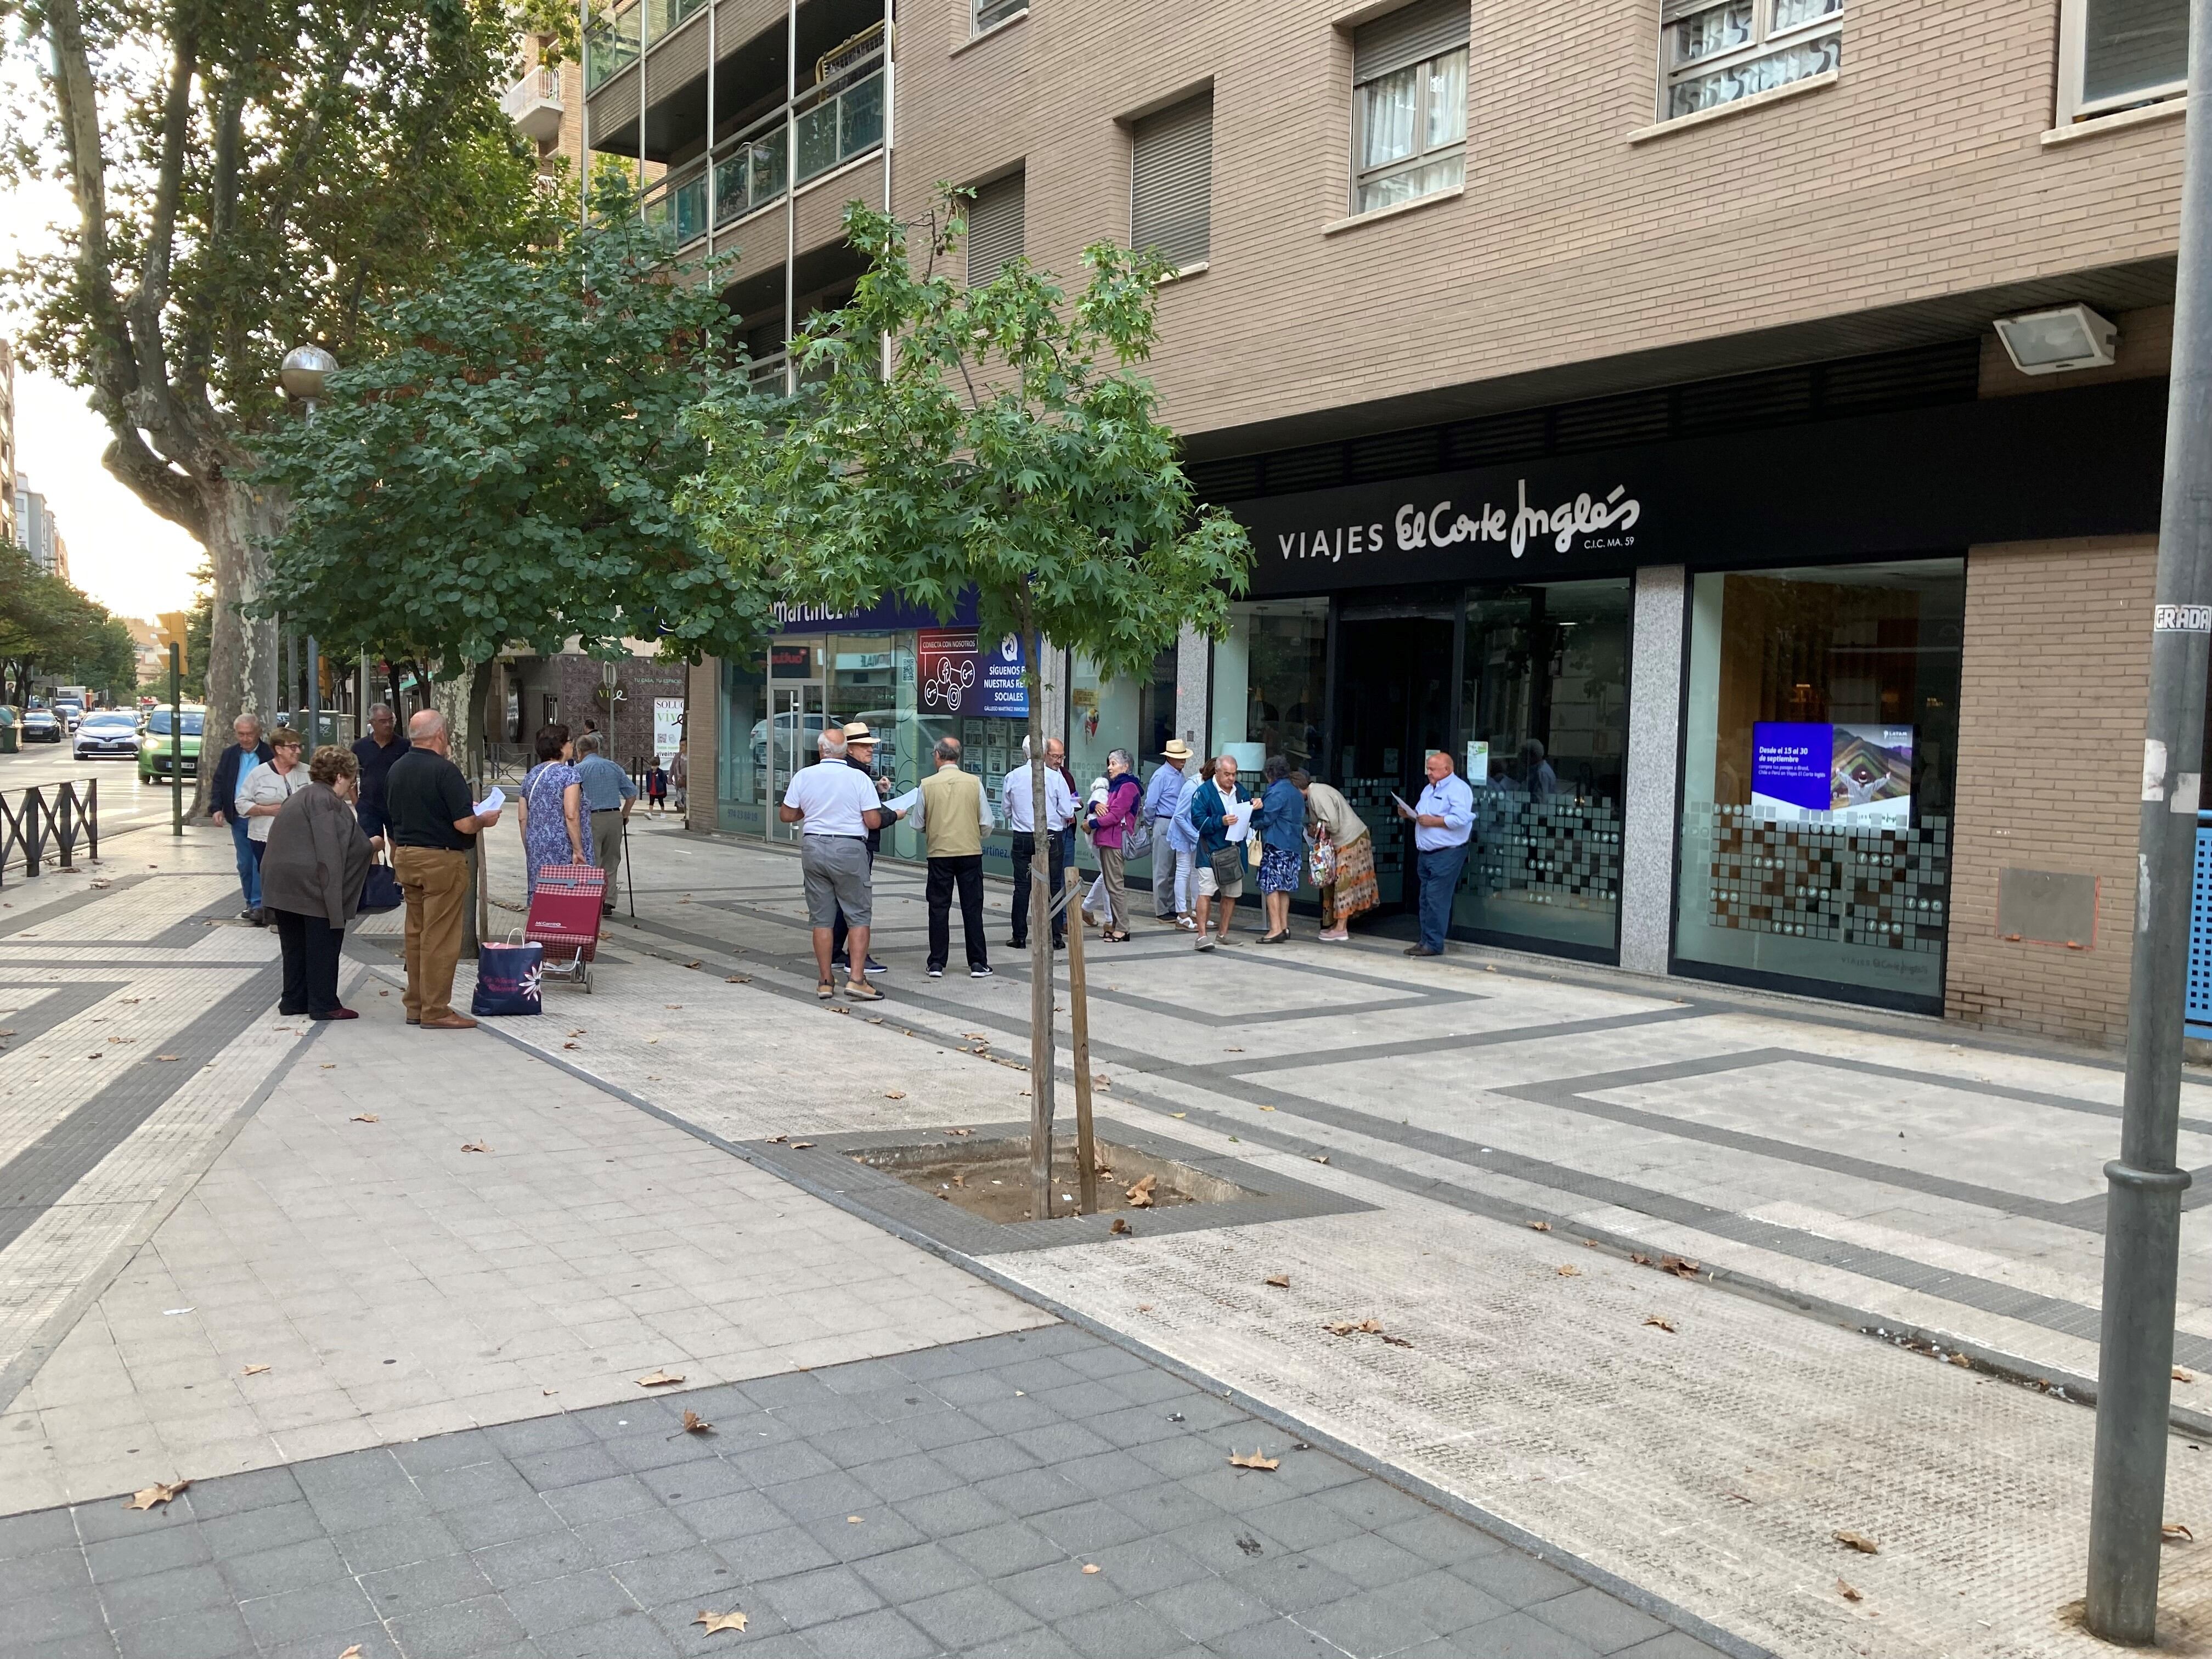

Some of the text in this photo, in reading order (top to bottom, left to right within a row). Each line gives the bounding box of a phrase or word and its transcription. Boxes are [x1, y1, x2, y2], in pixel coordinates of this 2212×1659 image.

[1278, 479, 1640, 563] VIAJES El Corte Inglés
[1584, 536, 1635, 549] C.I.C. MA. 59
[989, 664, 1020, 675] SÍGUENOS
[984, 679, 1025, 689] NUESTRAS RE
[994, 692, 1024, 702] SOCIALES
[1759, 746, 1777, 754] Desde
[1777, 746, 1783, 754] el
[1784, 747, 1792, 755] 15
[1799, 747, 1809, 755] 30
[1767, 755, 1799, 764] septiembre
